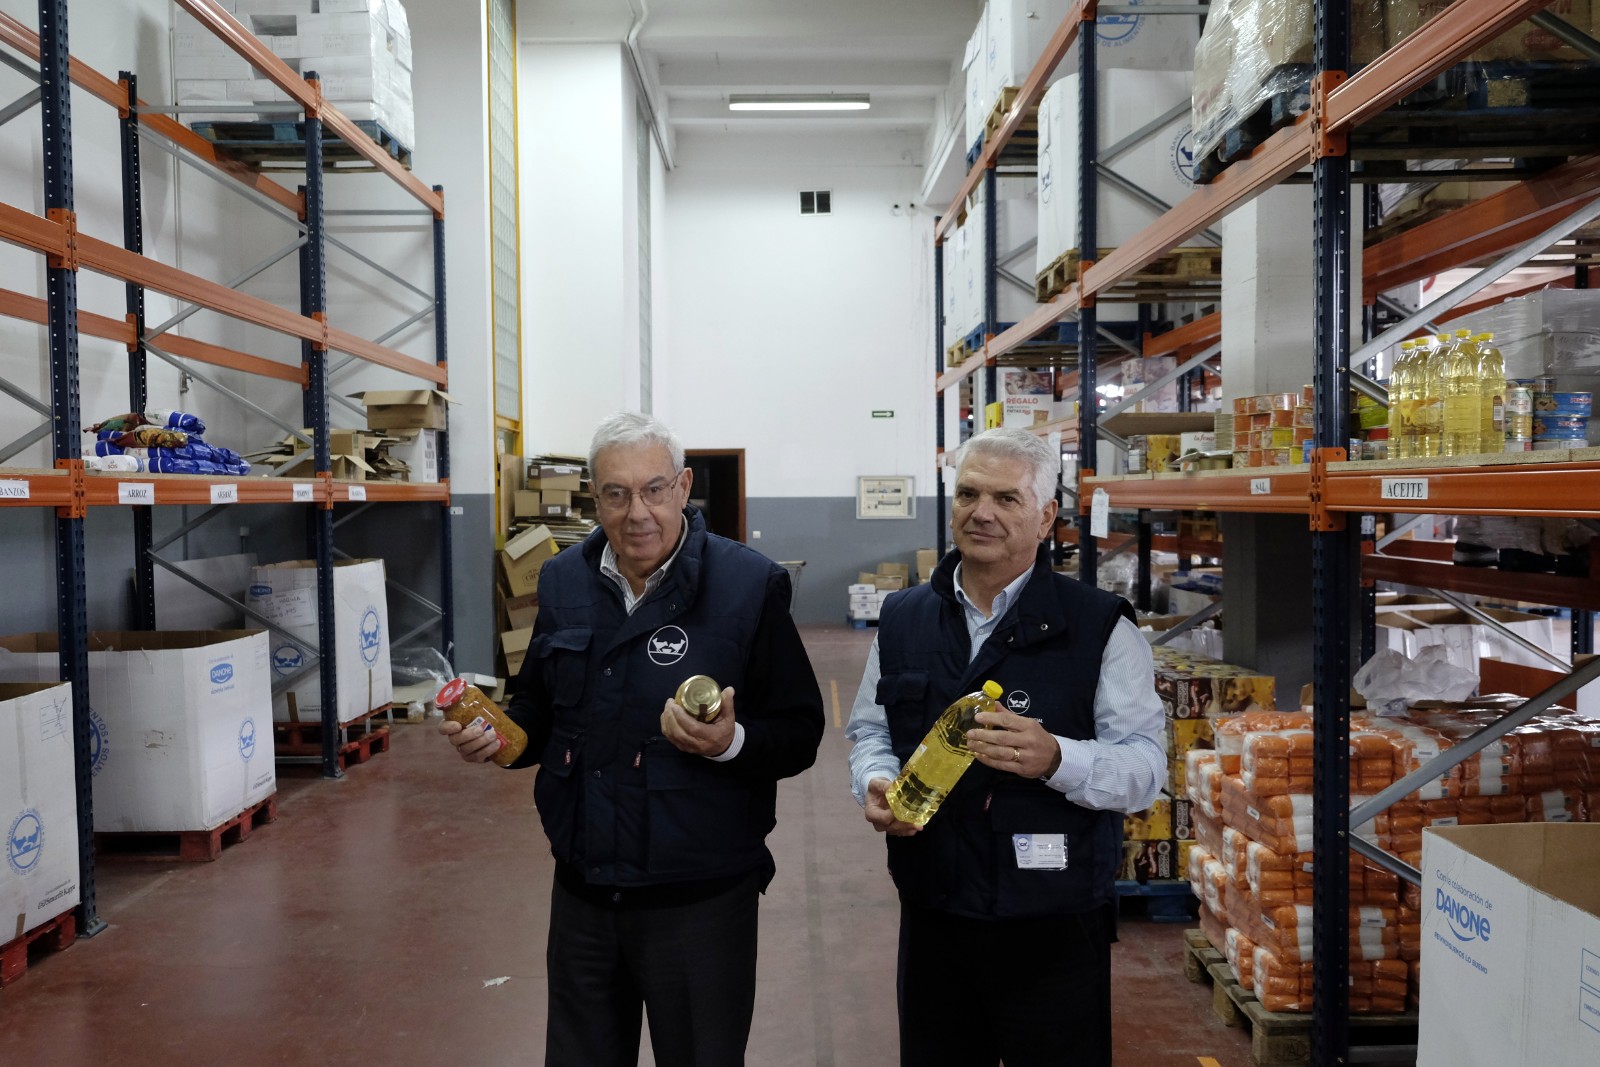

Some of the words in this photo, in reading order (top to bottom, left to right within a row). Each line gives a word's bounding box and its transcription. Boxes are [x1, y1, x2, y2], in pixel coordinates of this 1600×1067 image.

[1006, 397, 1038, 405] REGALO
[128, 489, 147, 498] ARROZ
[1387, 482, 1423, 498] ACEITE
[1436, 869, 1447, 881] Con
[1451, 881, 1484, 907] colaboración
[1484, 900, 1493, 911] de
[1465, 954, 1472, 963] LO
